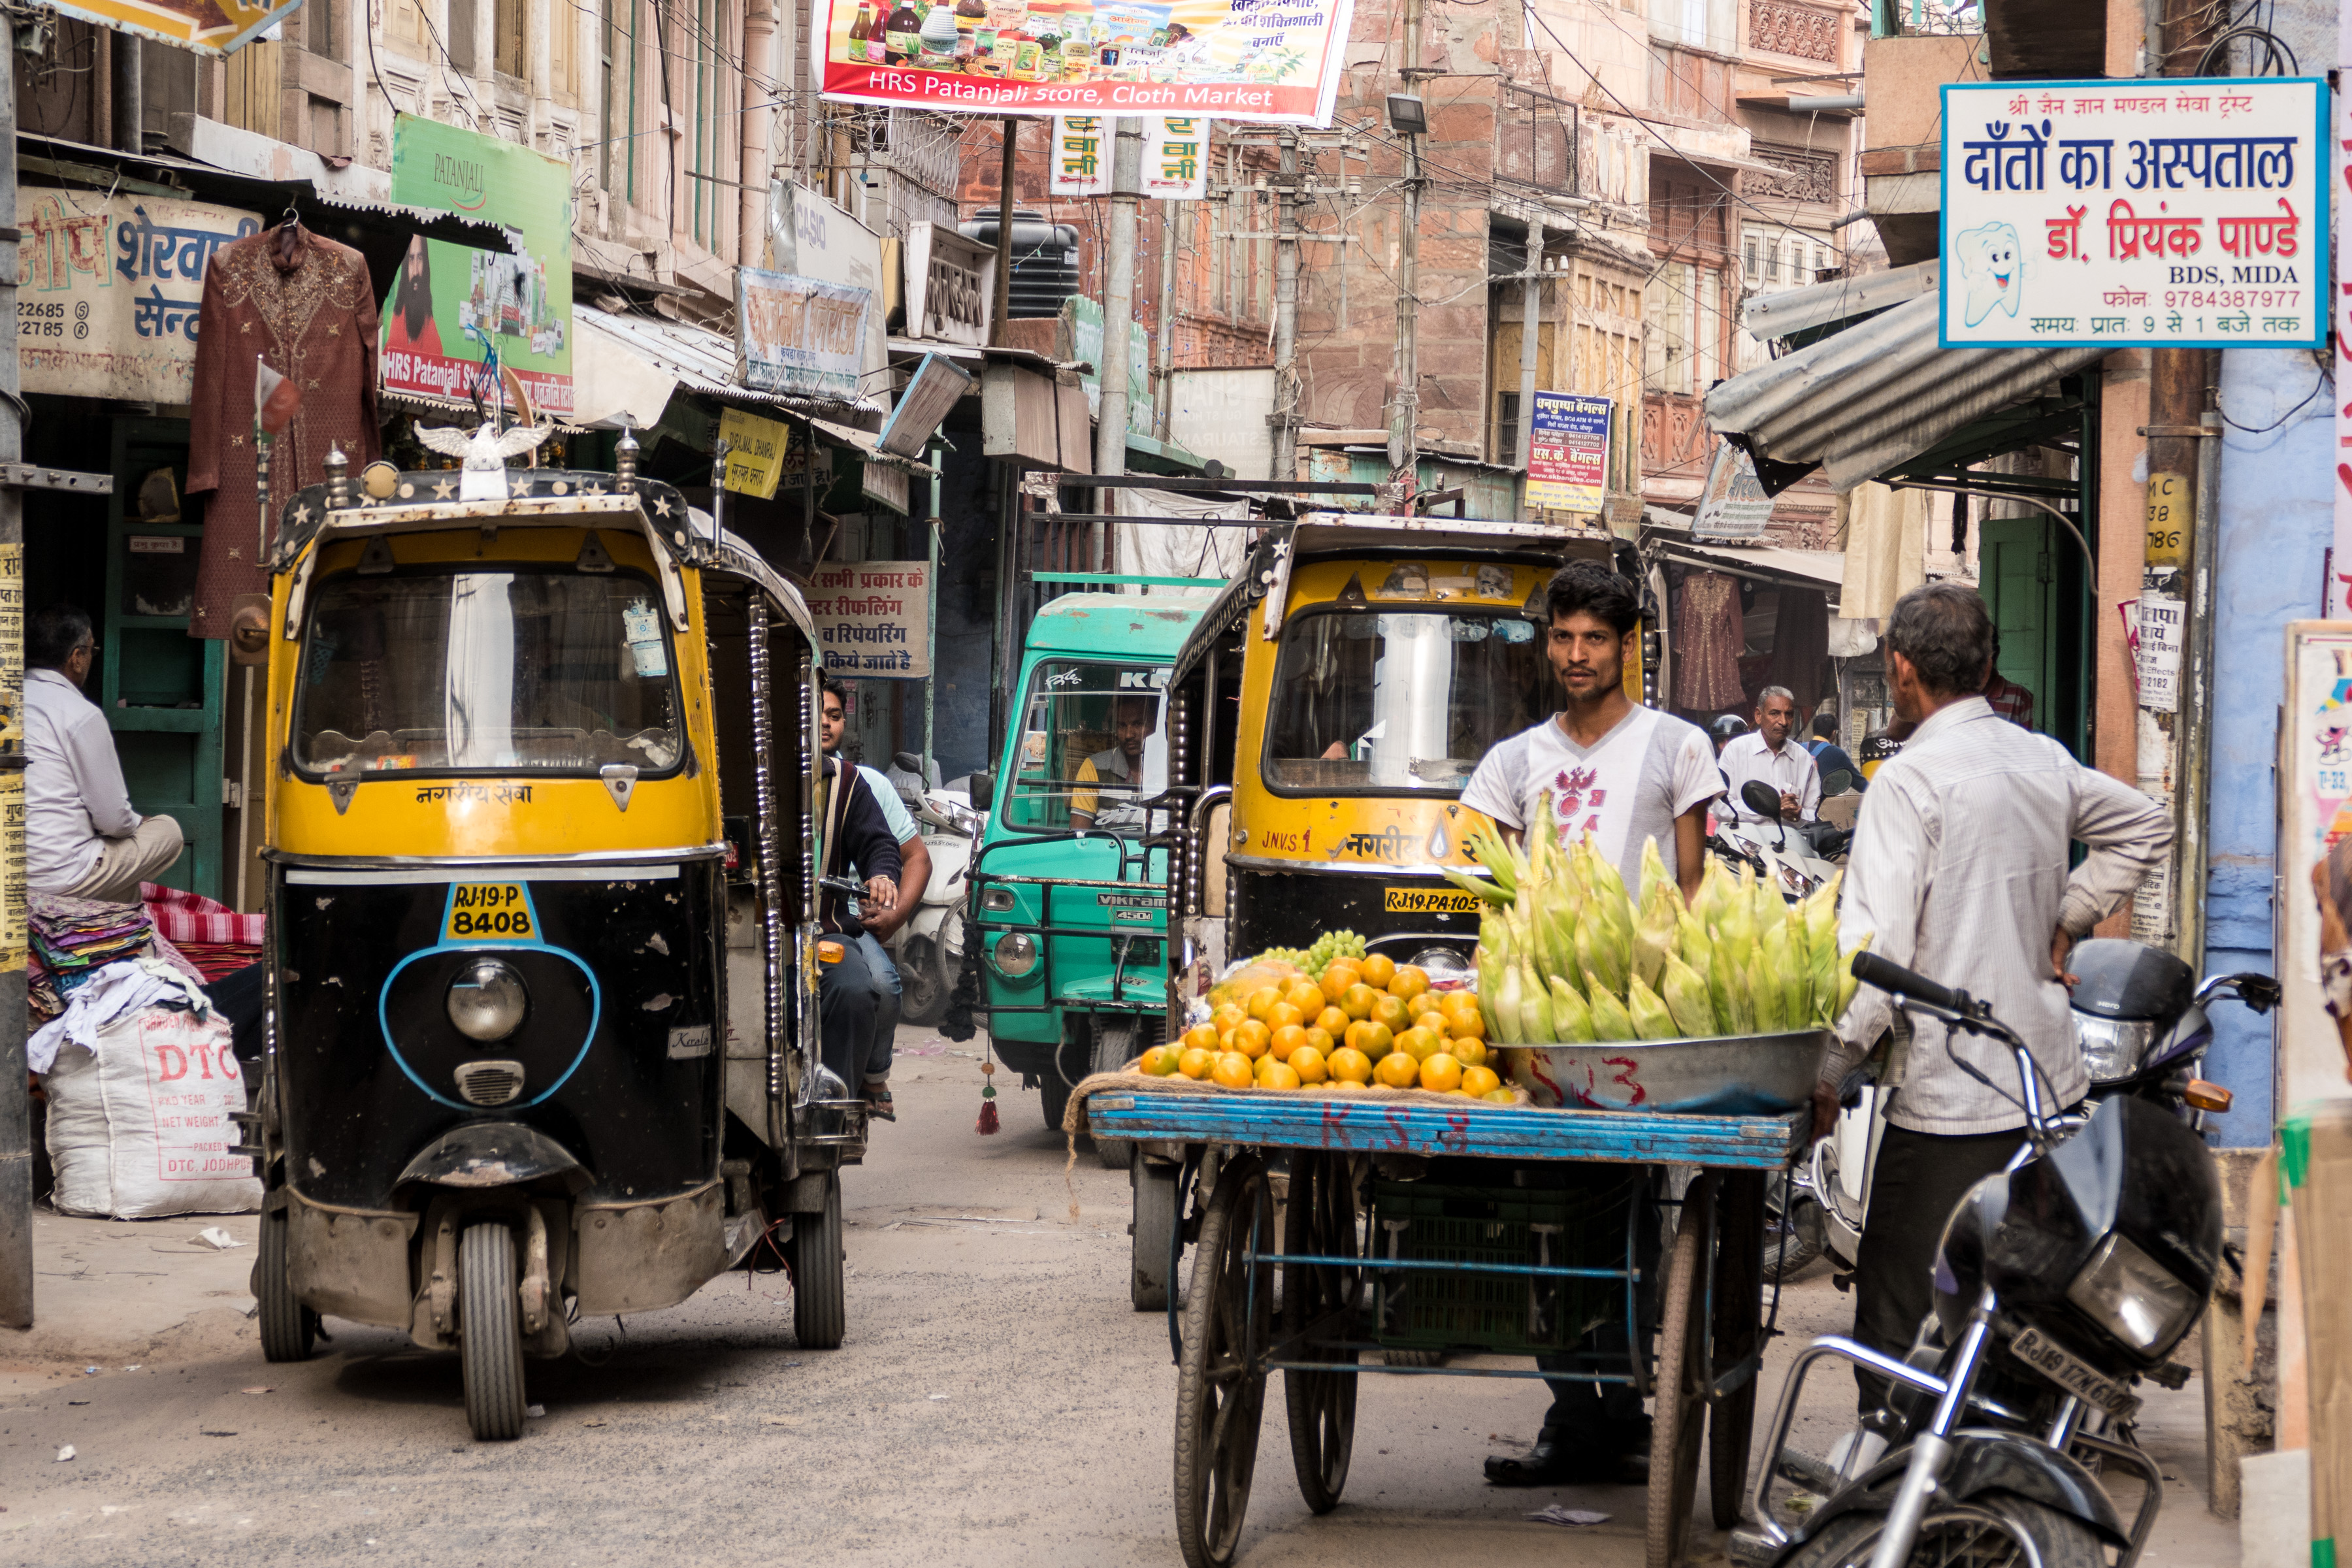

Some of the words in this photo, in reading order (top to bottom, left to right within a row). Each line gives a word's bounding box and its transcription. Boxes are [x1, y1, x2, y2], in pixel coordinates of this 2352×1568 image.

[870, 71, 916, 92] HRS
[925, 77, 1028, 105] Patanjali
[1113, 86, 1175, 103] Cloth
[1184, 88, 1273, 106] Market
[2009, 94, 2028, 115] श्री
[2037, 94, 2065, 114] जैन
[2074, 97, 2105, 118] ज्ञान
[2114, 97, 2166, 114] मण्डल
[2176, 90, 2210, 113] सेवा
[1963, 118, 2052, 191] दाँतों
[2059, 136, 2114, 191] का
[2125, 136, 2298, 190] अस्पताल
[434, 153, 484, 196] PATANJALI
[796, 203, 826, 251] CASIO
[2046, 204, 2091, 265] डॉ.
[2106, 198, 2203, 261] प्रियंक
[2217, 197, 2300, 259] पाण्डे
[2169, 267, 2224, 287] BDS,
[2232, 266, 2298, 284] MIDA
[2164, 291, 2301, 308] 9784387977
[17, 322, 63, 337] 2785
[2144, 317, 2155, 333] 9
[2166, 310, 2183, 333] से
[2198, 318, 2204, 332] 1
[2217, 311, 2251, 333] बजे
[2263, 317, 2300, 333] तक
[385, 351, 411, 382] HRS
[413, 357, 460, 389] Patanjali
[754, 439, 777, 461] DHANRAJ
[1529, 472, 1601, 484] www.skbangles.com
[821, 568, 855, 588] सभी
[860, 572, 904, 589] प्रकार
[907, 568, 924, 588] के
[836, 595, 903, 616] रीफलिंग
[822, 627, 835, 643] व
[837, 622, 907, 644] रिपेयरिंग
[823, 649, 859, 670] किये
[862, 649, 897, 670] जाते
[2147, 666, 2176, 676] Effects
[416, 780, 489, 804] नगरीय
[494, 779, 532, 806] सेवा
[1346, 825, 1423, 861] नगरीय
[453, 885, 518, 907] RJ-19-P
[1386, 890, 1488, 911] RJ.19.PA.105
[453, 911, 530, 935] 8408
[672, 1030, 709, 1048] Kerala
[154, 1043, 237, 1082] DTC
[181, 1094, 205, 1105] YEAR
[162, 1117, 182, 1128] NET
[184, 1115, 219, 1128] WEIGHT
[193, 1142, 221, 1152] PACKED
[168, 1159, 198, 1174] DTC,
[202, 1158, 252, 1172] JODHPUR
